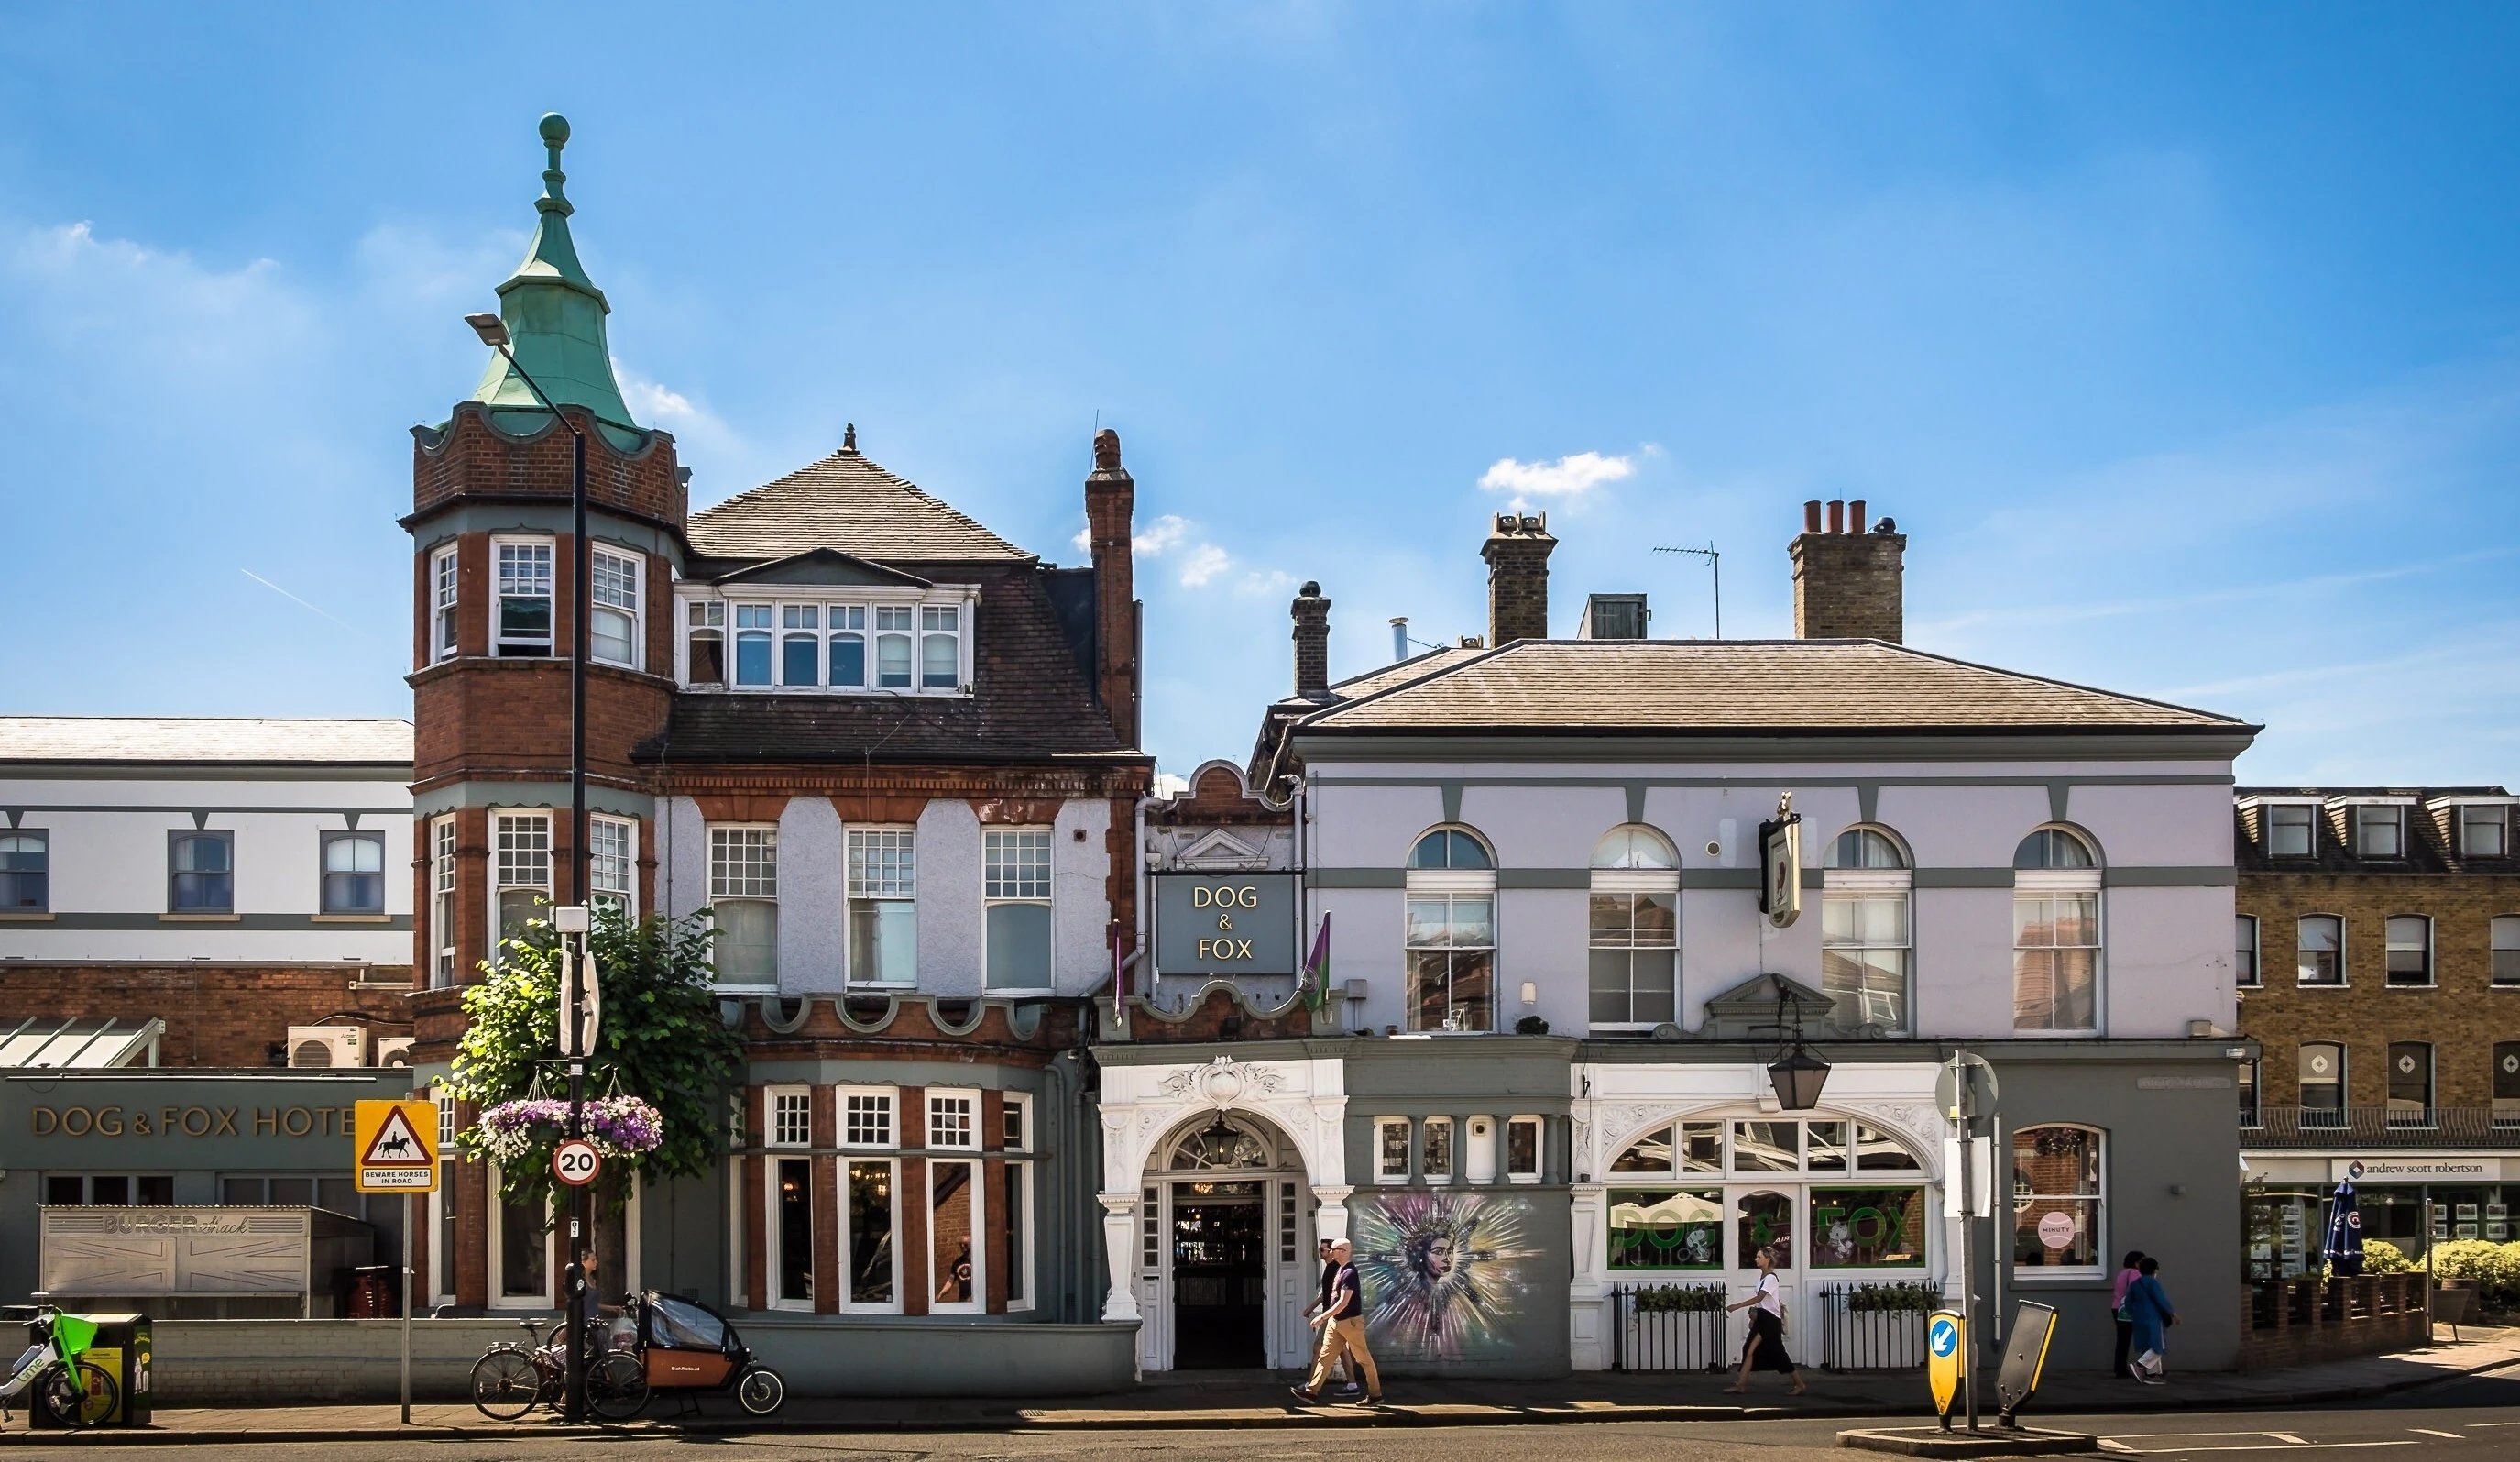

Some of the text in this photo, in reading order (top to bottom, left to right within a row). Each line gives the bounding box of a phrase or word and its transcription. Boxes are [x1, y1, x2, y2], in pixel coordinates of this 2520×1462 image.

[1193, 886, 1257, 907] DOG
[1219, 913, 1233, 929] &
[1199, 938, 1253, 960] FOX
[31, 1107, 356, 1136] DOG & FOX HOTE
[561, 1153, 594, 1171] 20
[2366, 1162, 2482, 1173] andrew scott robertson
[103, 1215, 250, 1234] BURGER Shack
[1815, 1205, 1913, 1249] FOX
